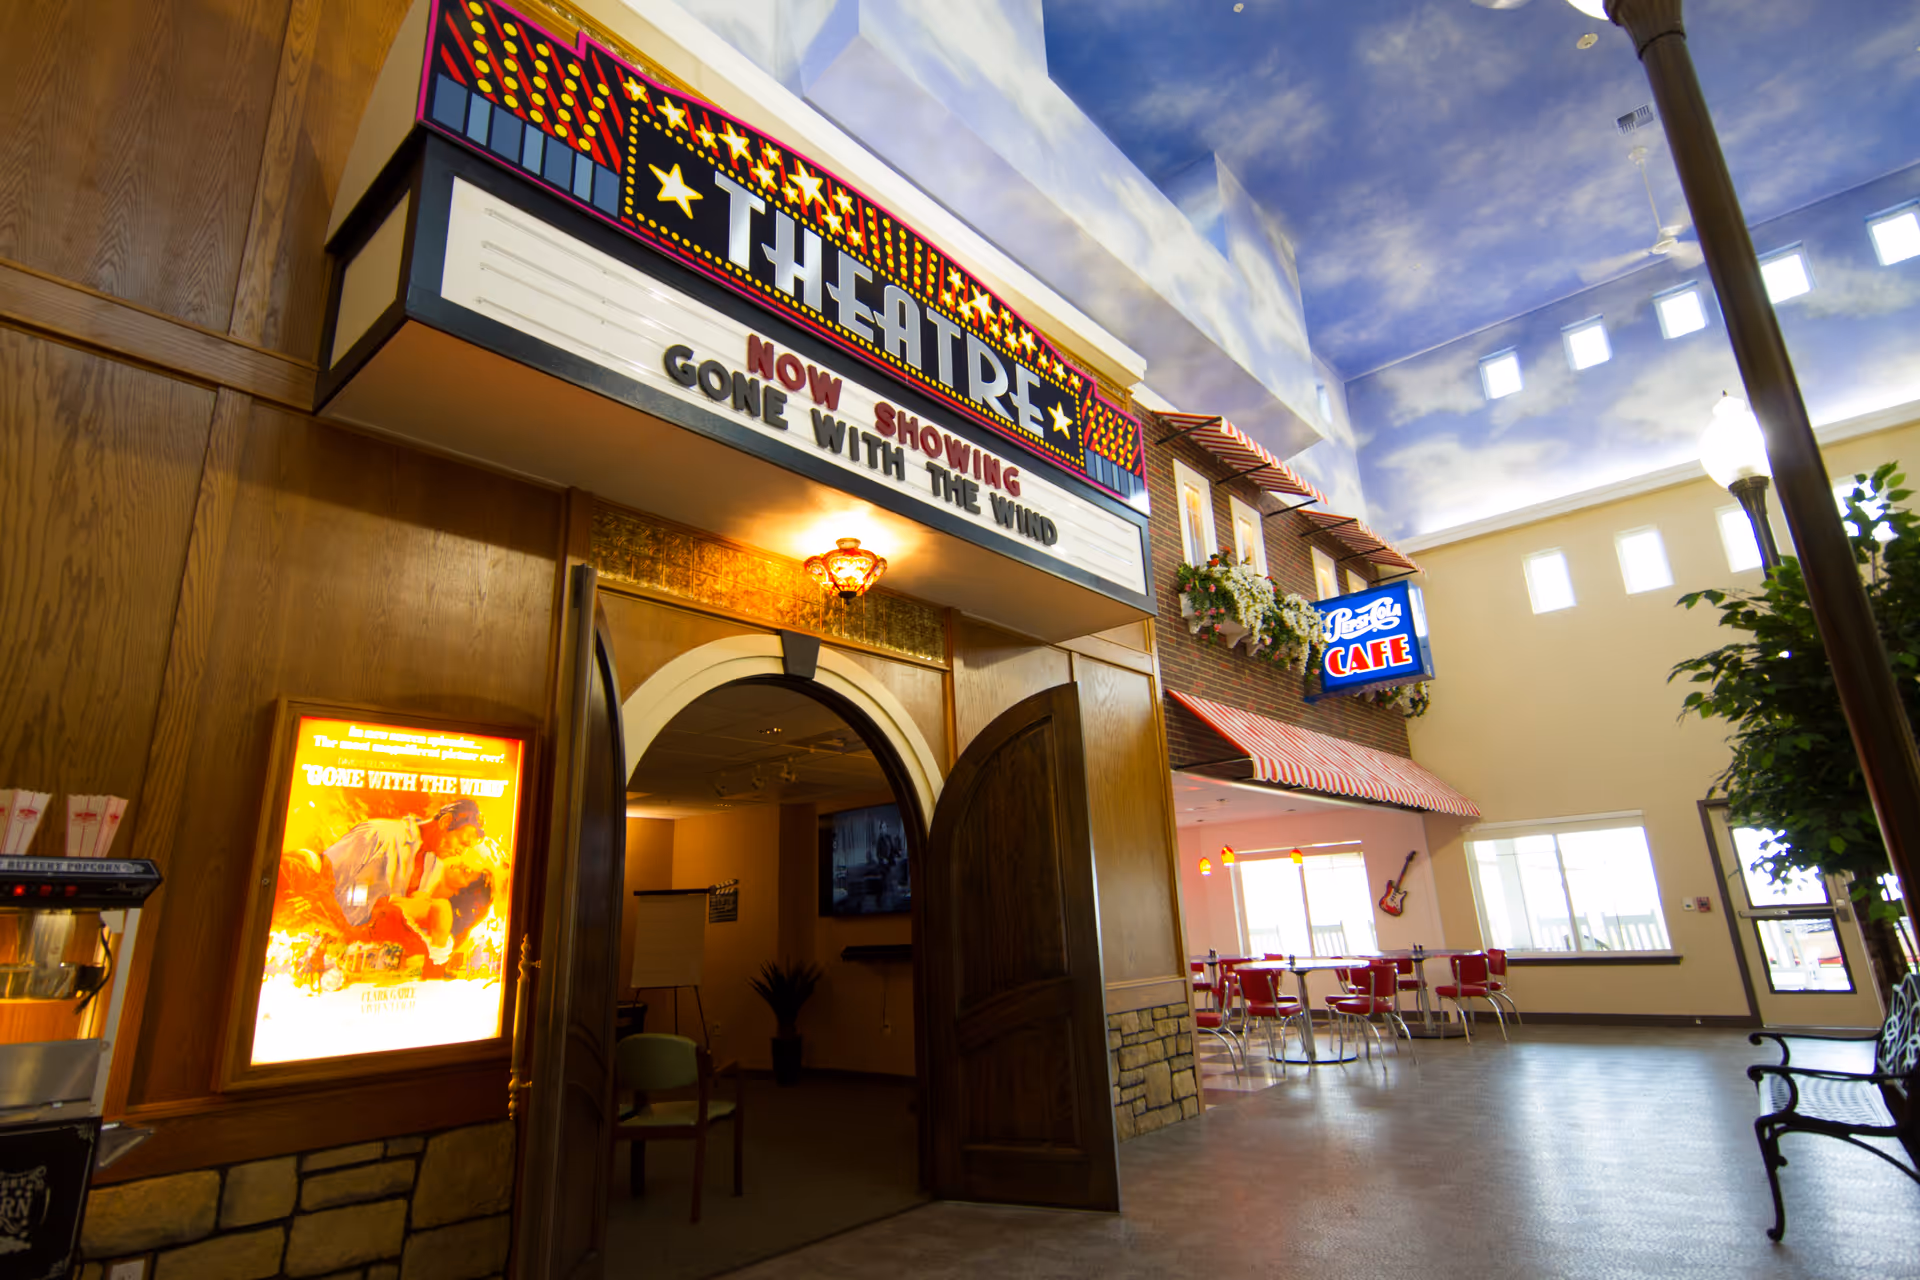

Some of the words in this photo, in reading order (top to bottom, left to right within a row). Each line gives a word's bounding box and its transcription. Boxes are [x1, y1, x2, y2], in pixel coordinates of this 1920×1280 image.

[715, 171, 1044, 438] THEATRE
[747, 333, 843, 411] NOW
[873, 401, 1021, 496] SHOWING
[664, 344, 789, 430] GONE
[810, 408, 905, 480] WITH
[926, 461, 981, 515] THE
[989, 492, 1058, 546] WIND
[1325, 633, 1413, 677] CAFE
[313, 734, 338, 749] The
[368, 770, 418, 791] WITH
[420, 776, 457, 794] THE
[67, 862, 122, 874] POPCORN
